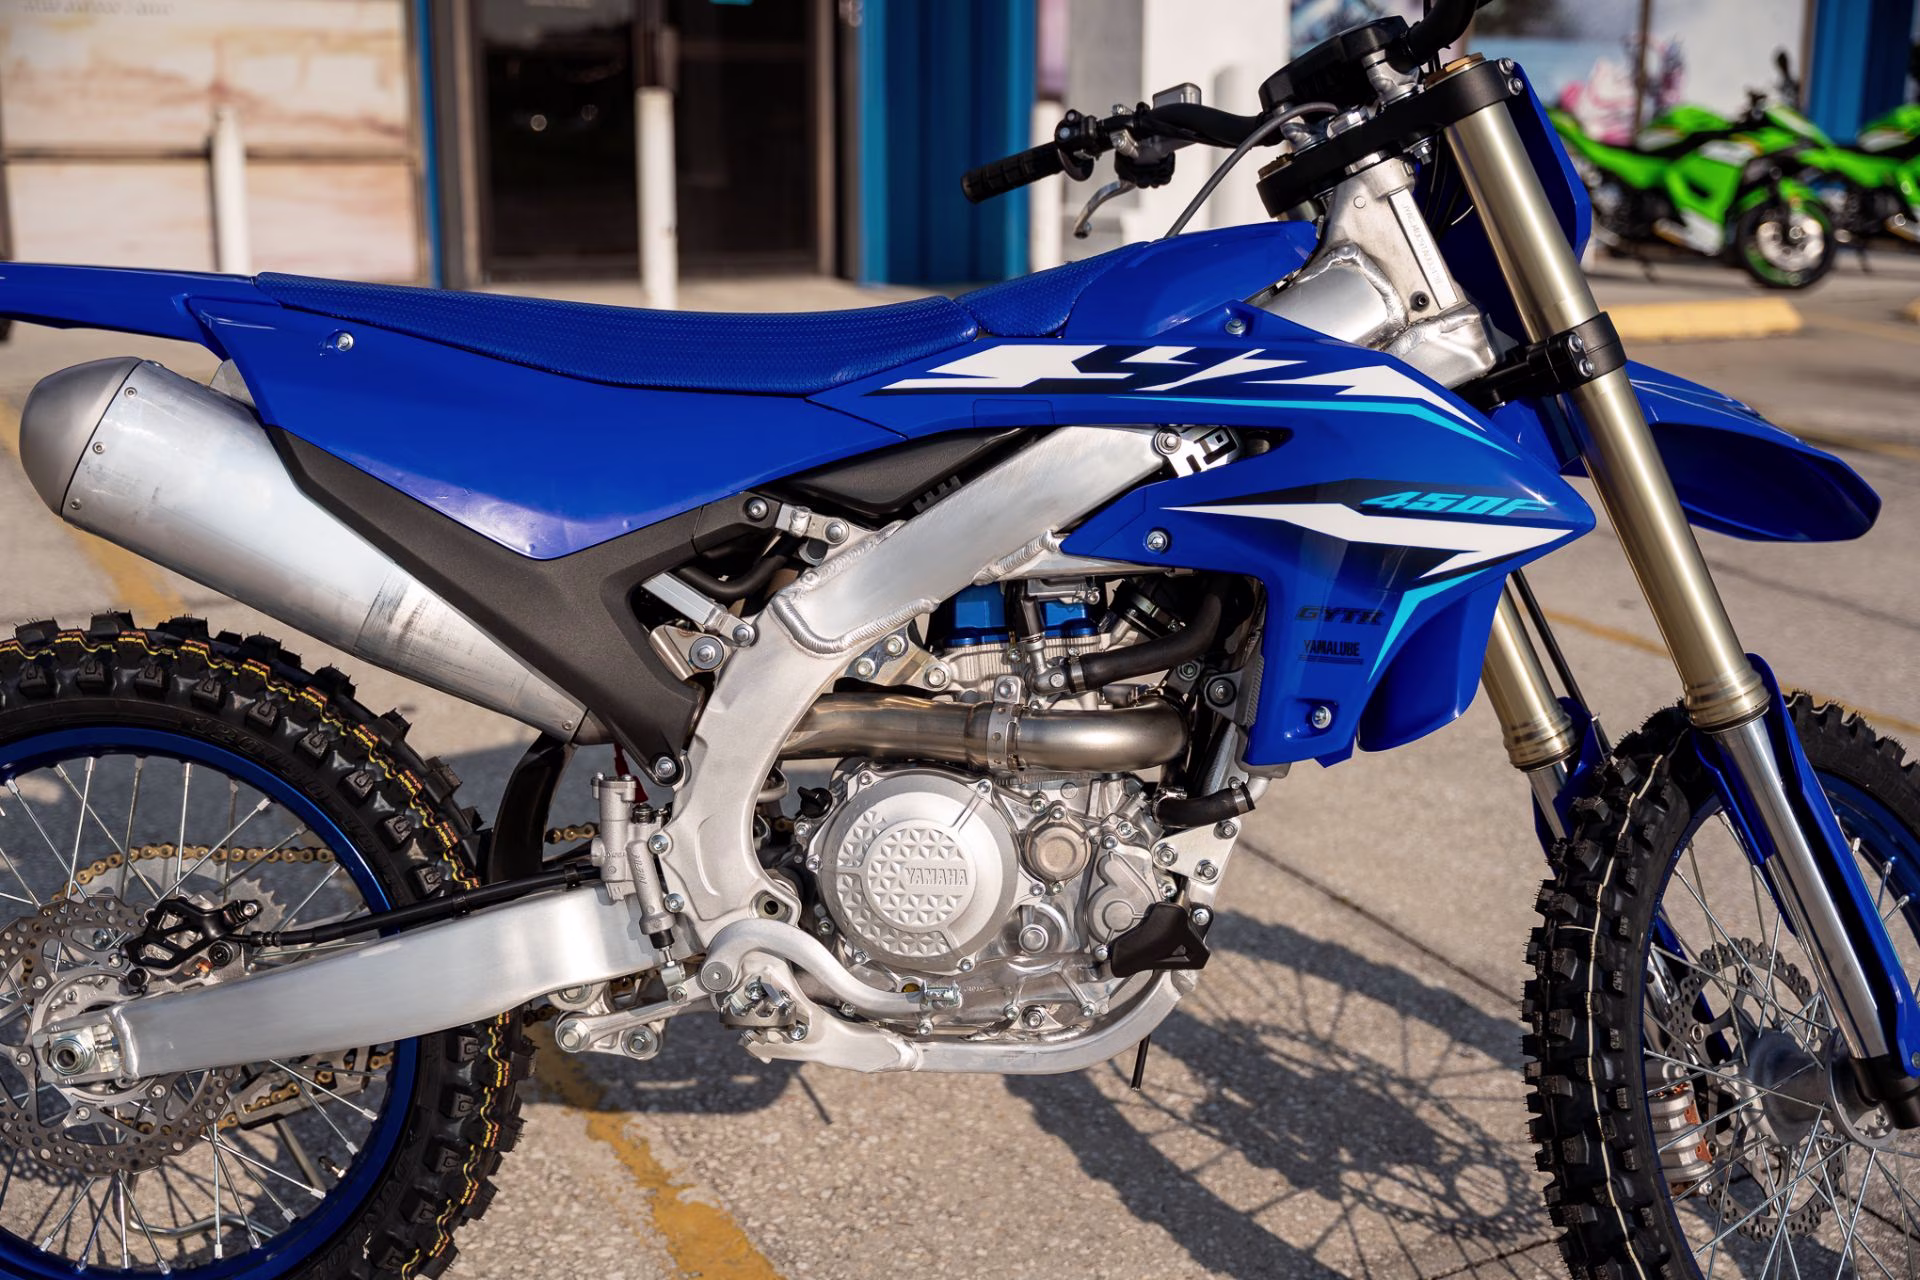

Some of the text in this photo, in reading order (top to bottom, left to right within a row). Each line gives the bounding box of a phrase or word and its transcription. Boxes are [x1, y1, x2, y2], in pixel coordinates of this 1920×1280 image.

[1359, 491, 1558, 517] 450F
[1296, 605, 1386, 626] GYTR
[1303, 639, 1361, 657] YAMALUBE
[904, 867, 969, 886] YAMAHA
